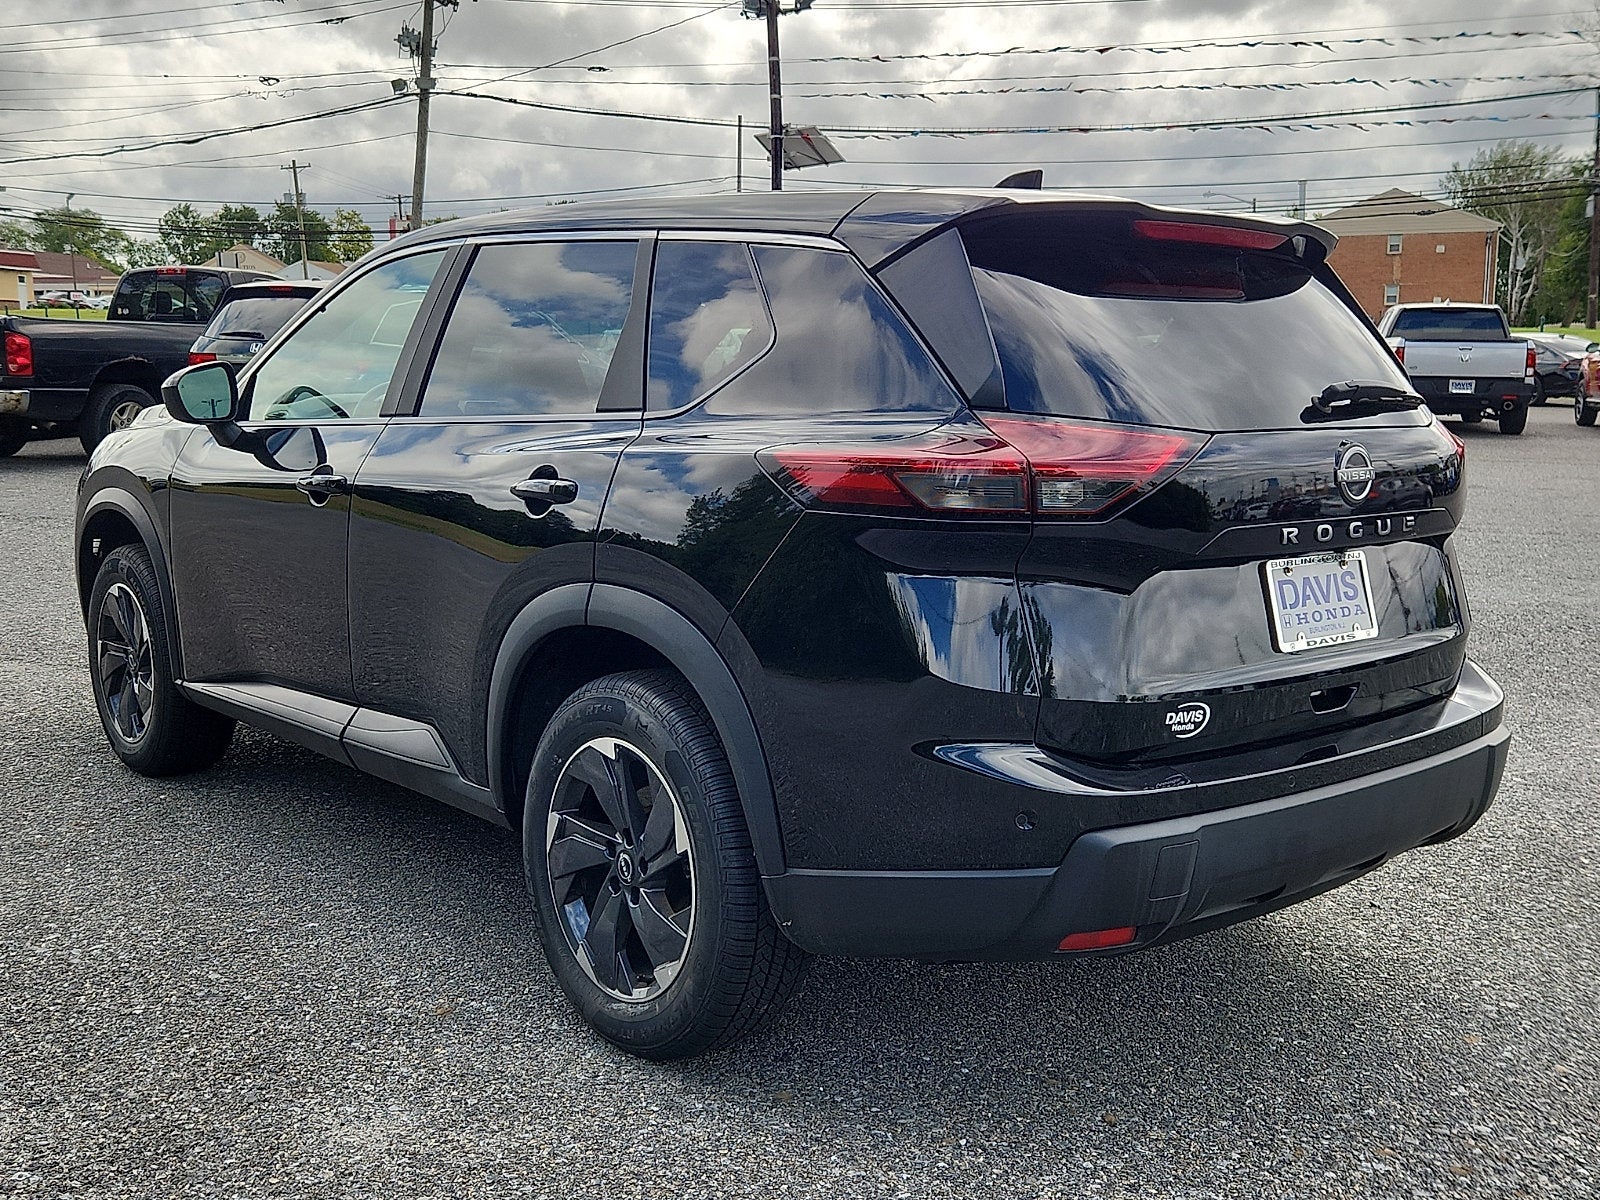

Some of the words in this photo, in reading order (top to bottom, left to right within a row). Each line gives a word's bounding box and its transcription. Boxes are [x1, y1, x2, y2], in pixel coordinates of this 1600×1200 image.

[1338, 469, 1376, 482] NISSAN
[1281, 515, 1416, 545] ROGUE
[1277, 570, 1359, 610] DAVIS
[1296, 604, 1366, 625] HONDA
[1306, 634, 1356, 647] DAVIS
[1165, 709, 1204, 725] DAVIS
[1171, 723, 1195, 732] Honda
